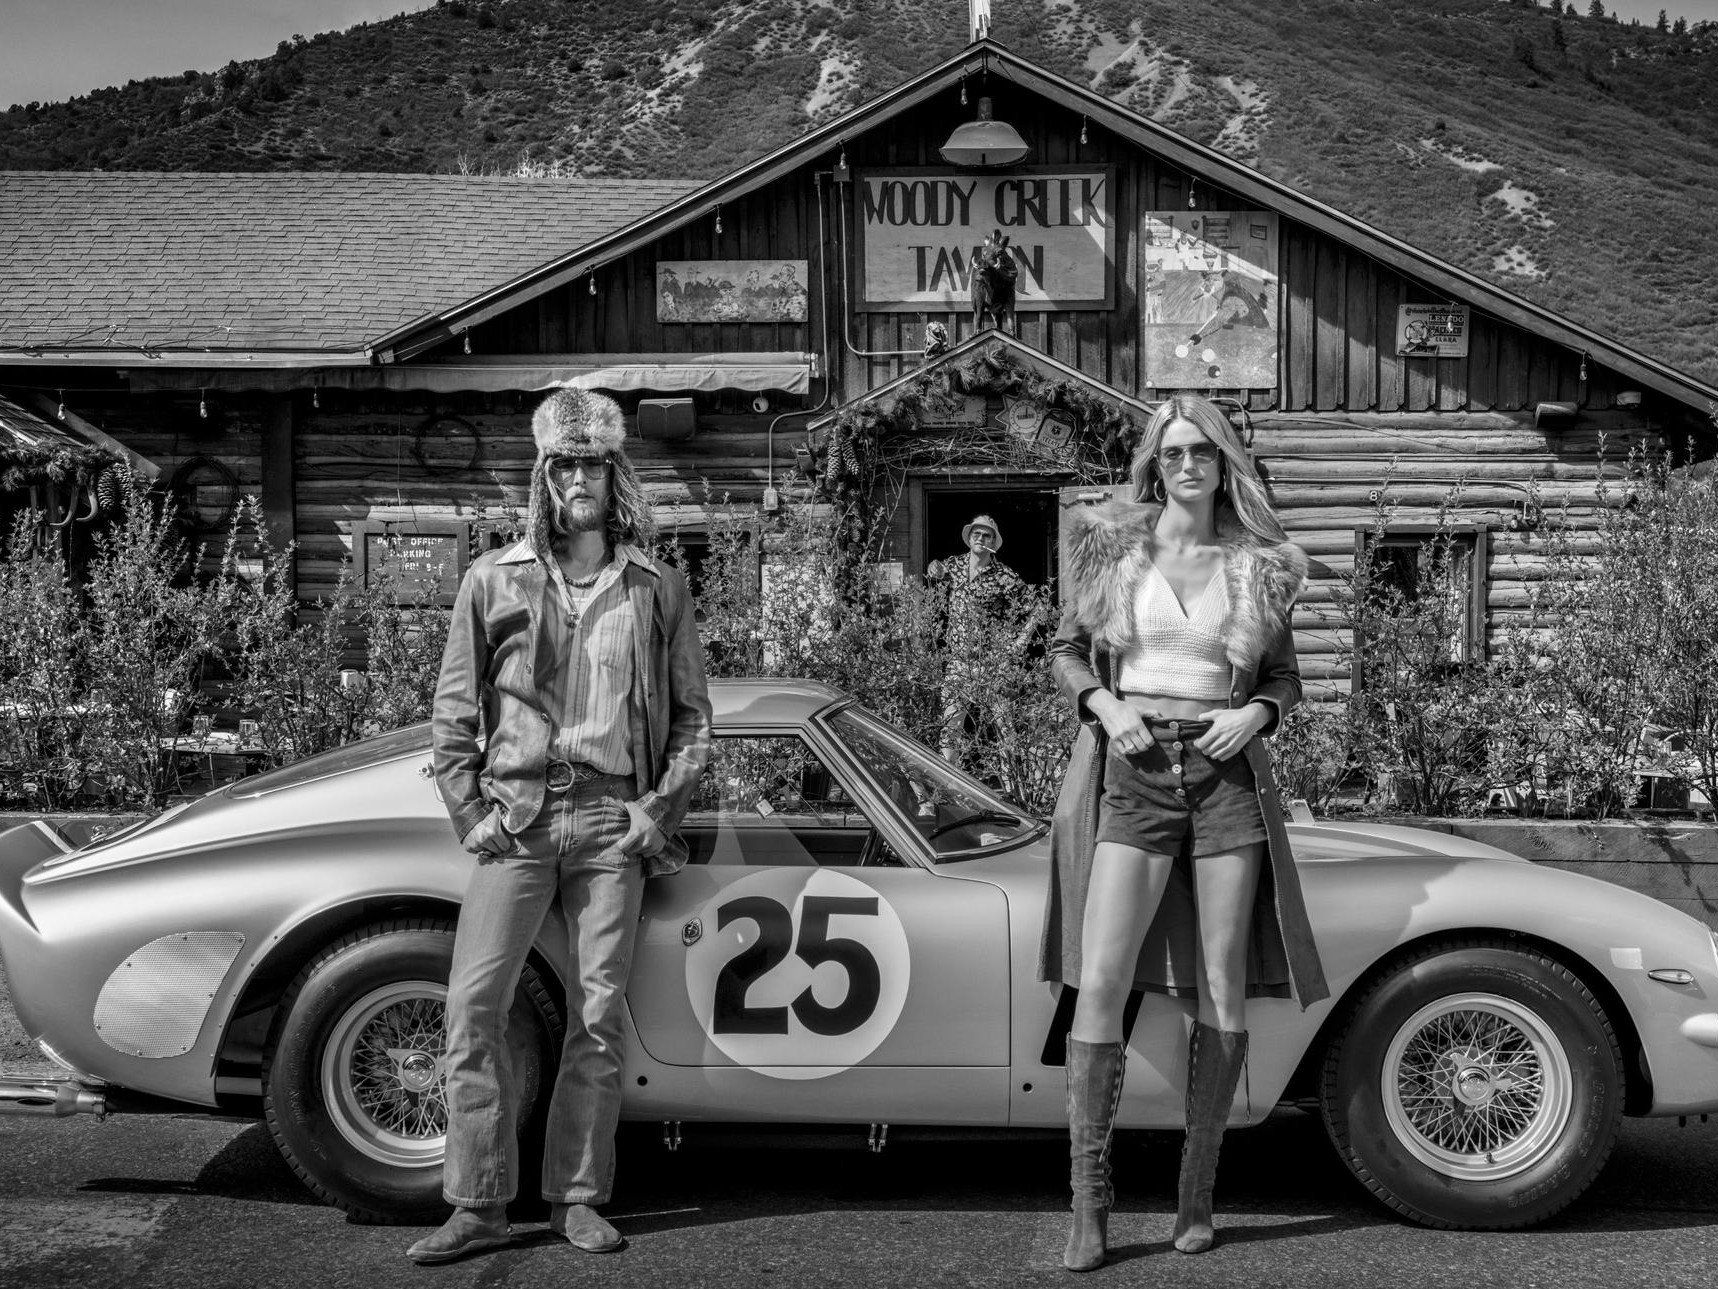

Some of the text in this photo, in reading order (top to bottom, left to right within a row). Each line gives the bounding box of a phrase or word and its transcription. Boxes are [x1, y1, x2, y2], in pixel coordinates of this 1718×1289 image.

[864, 178, 1108, 229] WOODY CREEK
[908, 245, 1046, 296] TAVN
[713, 895, 881, 1037] 25
